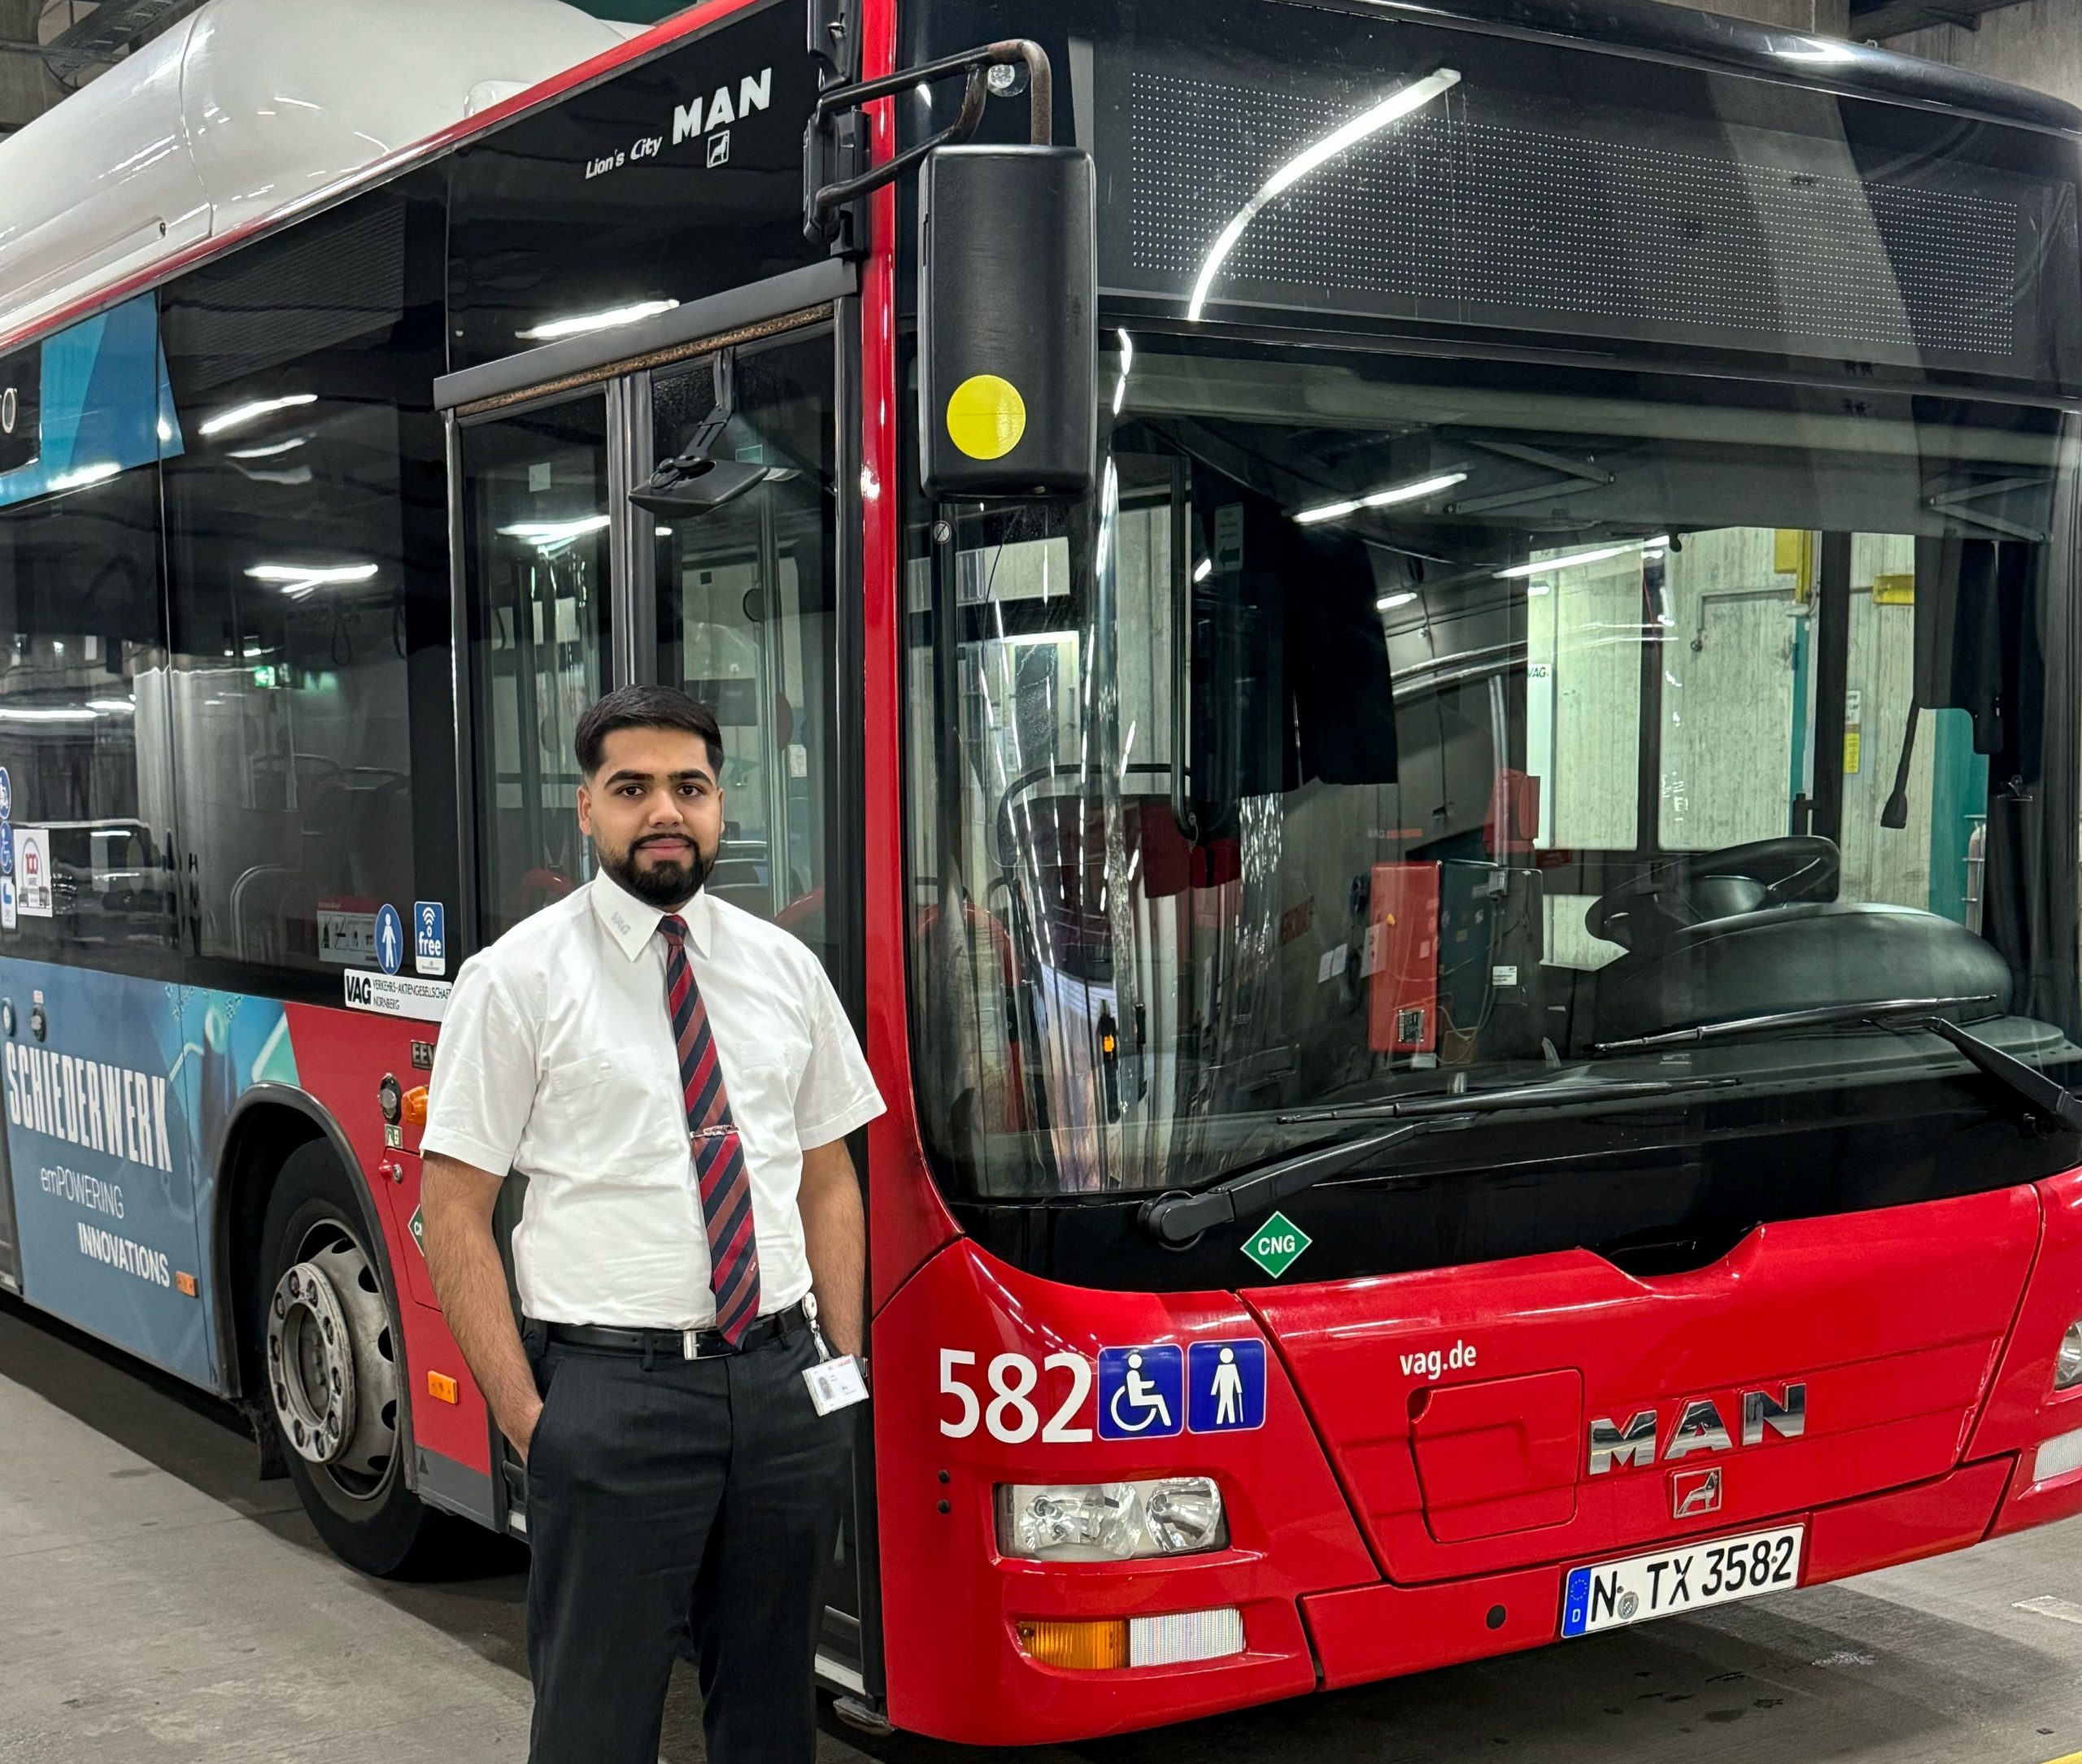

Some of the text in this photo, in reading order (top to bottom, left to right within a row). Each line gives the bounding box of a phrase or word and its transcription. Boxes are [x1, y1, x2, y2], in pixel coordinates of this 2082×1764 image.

[673, 68, 772, 145] MAN
[585, 136, 663, 180] Lion's City
[419, 931, 442, 956] free
[346, 975, 372, 1005] VAG
[6, 1042, 172, 1173] SCHIEDERWERK
[41, 1165, 124, 1219] emPOWERING
[78, 1222, 170, 1287] INNOVATIONS
[1258, 1235, 1296, 1256] CNG
[1400, 1339, 1476, 1380] vag.de
[940, 1348, 1093, 1444] 582
[1589, 1383, 1806, 1475] MAN
[1591, 1535, 1794, 1622] N TX 3582
[1571, 1609, 1580, 1623] D
